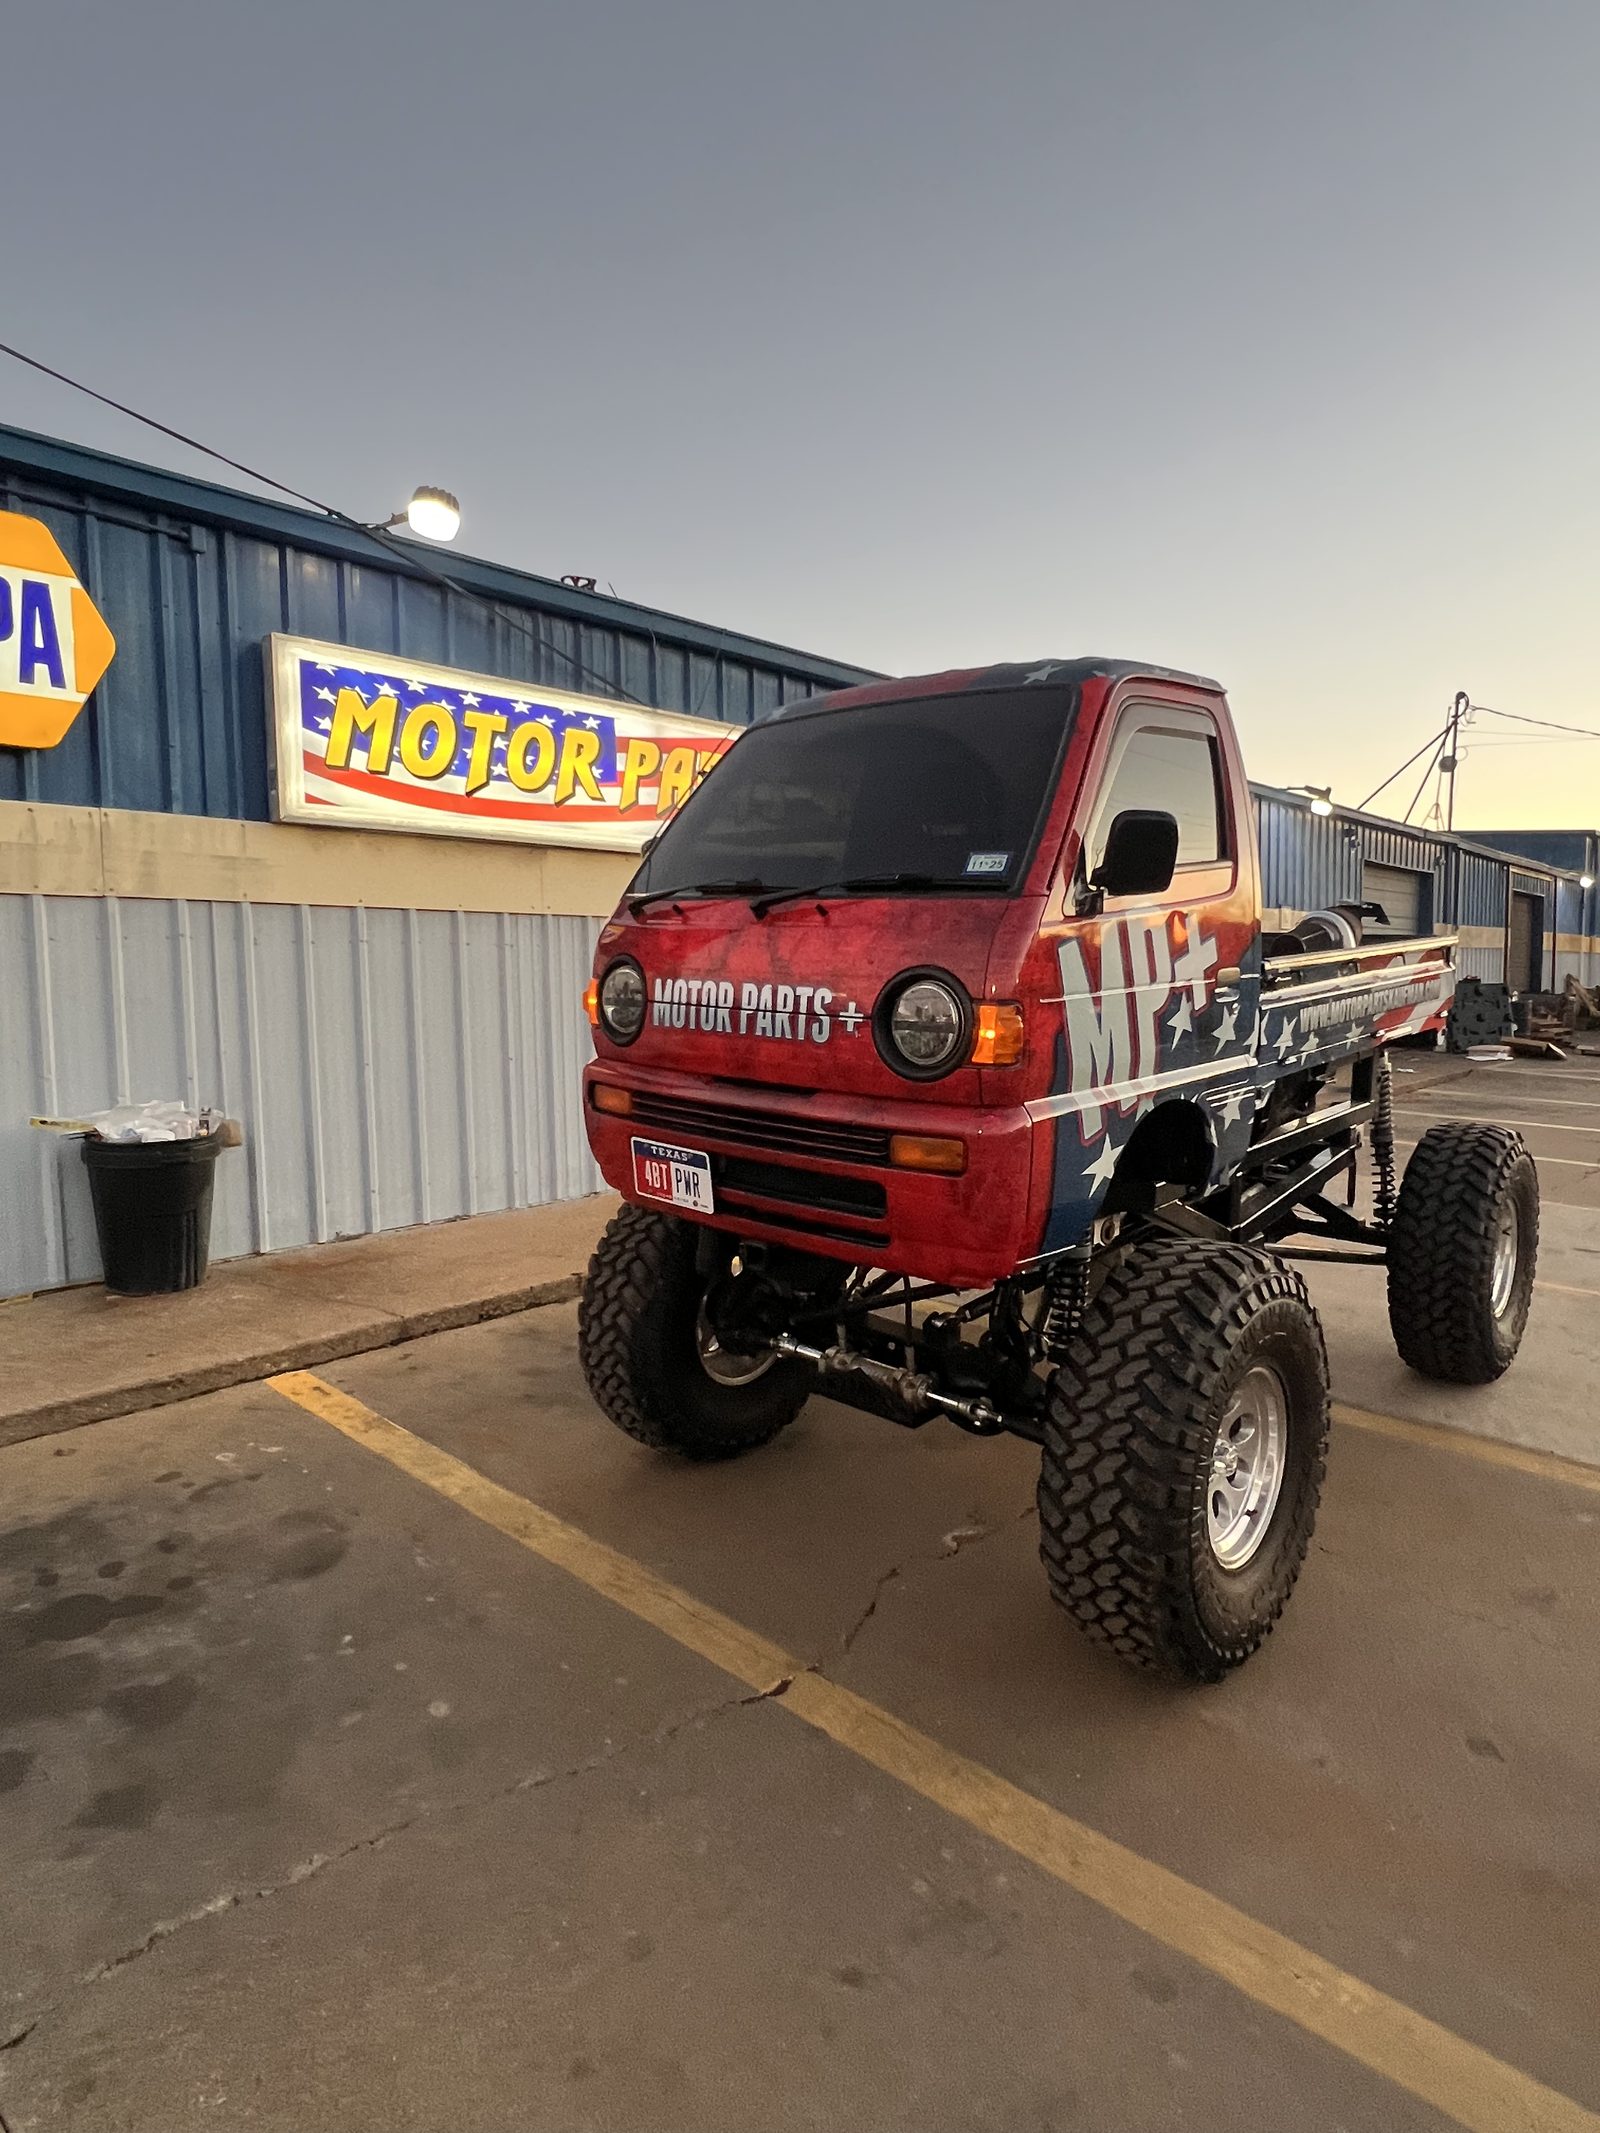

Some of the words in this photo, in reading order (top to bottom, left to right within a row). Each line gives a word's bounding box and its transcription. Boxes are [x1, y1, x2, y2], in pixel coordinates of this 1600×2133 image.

[325, 688, 607, 808] MOTOR
[653, 978, 735, 1033] MOTOR
[739, 982, 833, 1043] PARTS
[650, 1146, 688, 1162] TEXAS
[675, 1167, 701, 1199] PWR
